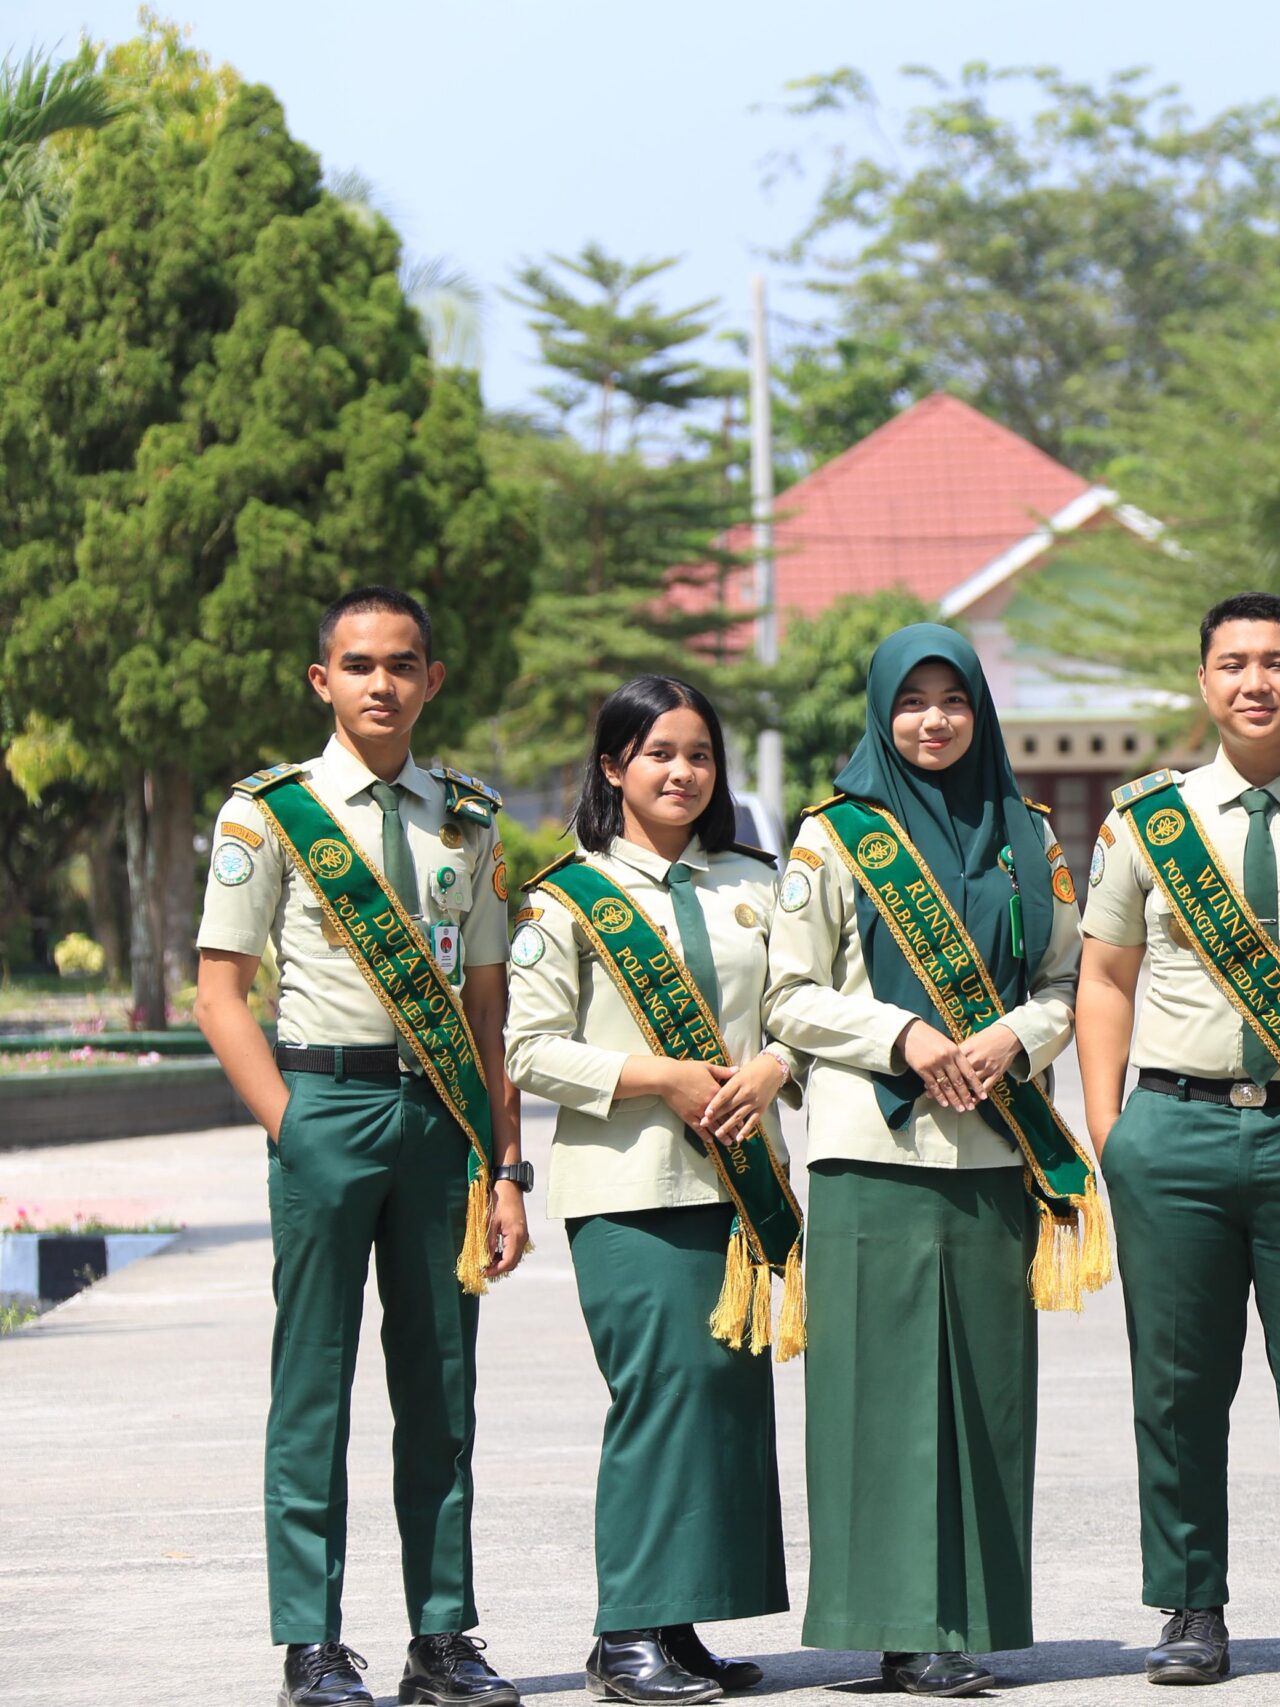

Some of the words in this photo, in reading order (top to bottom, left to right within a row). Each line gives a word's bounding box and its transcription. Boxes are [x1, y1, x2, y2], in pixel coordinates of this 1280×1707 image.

[334, 894, 406, 997] POLBANGTAN
[398, 993, 442, 1050] MEDAN
[879, 881, 948, 984] POLBANGTAN
[905, 878, 970, 975] RUNNER
[960, 973, 985, 1005] UP
[975, 1006, 992, 1023] 2
[1162, 857, 1229, 957] POLBANGTAN
[1222, 955, 1269, 1011] MEDAN
[1196, 865, 1267, 970] WINNER
[373, 908, 422, 976] DUTA
[413, 970, 473, 1066] INOVATIF
[616, 946, 684, 1049] POLBANGTAN
[648, 950, 691, 1017] DUTA
